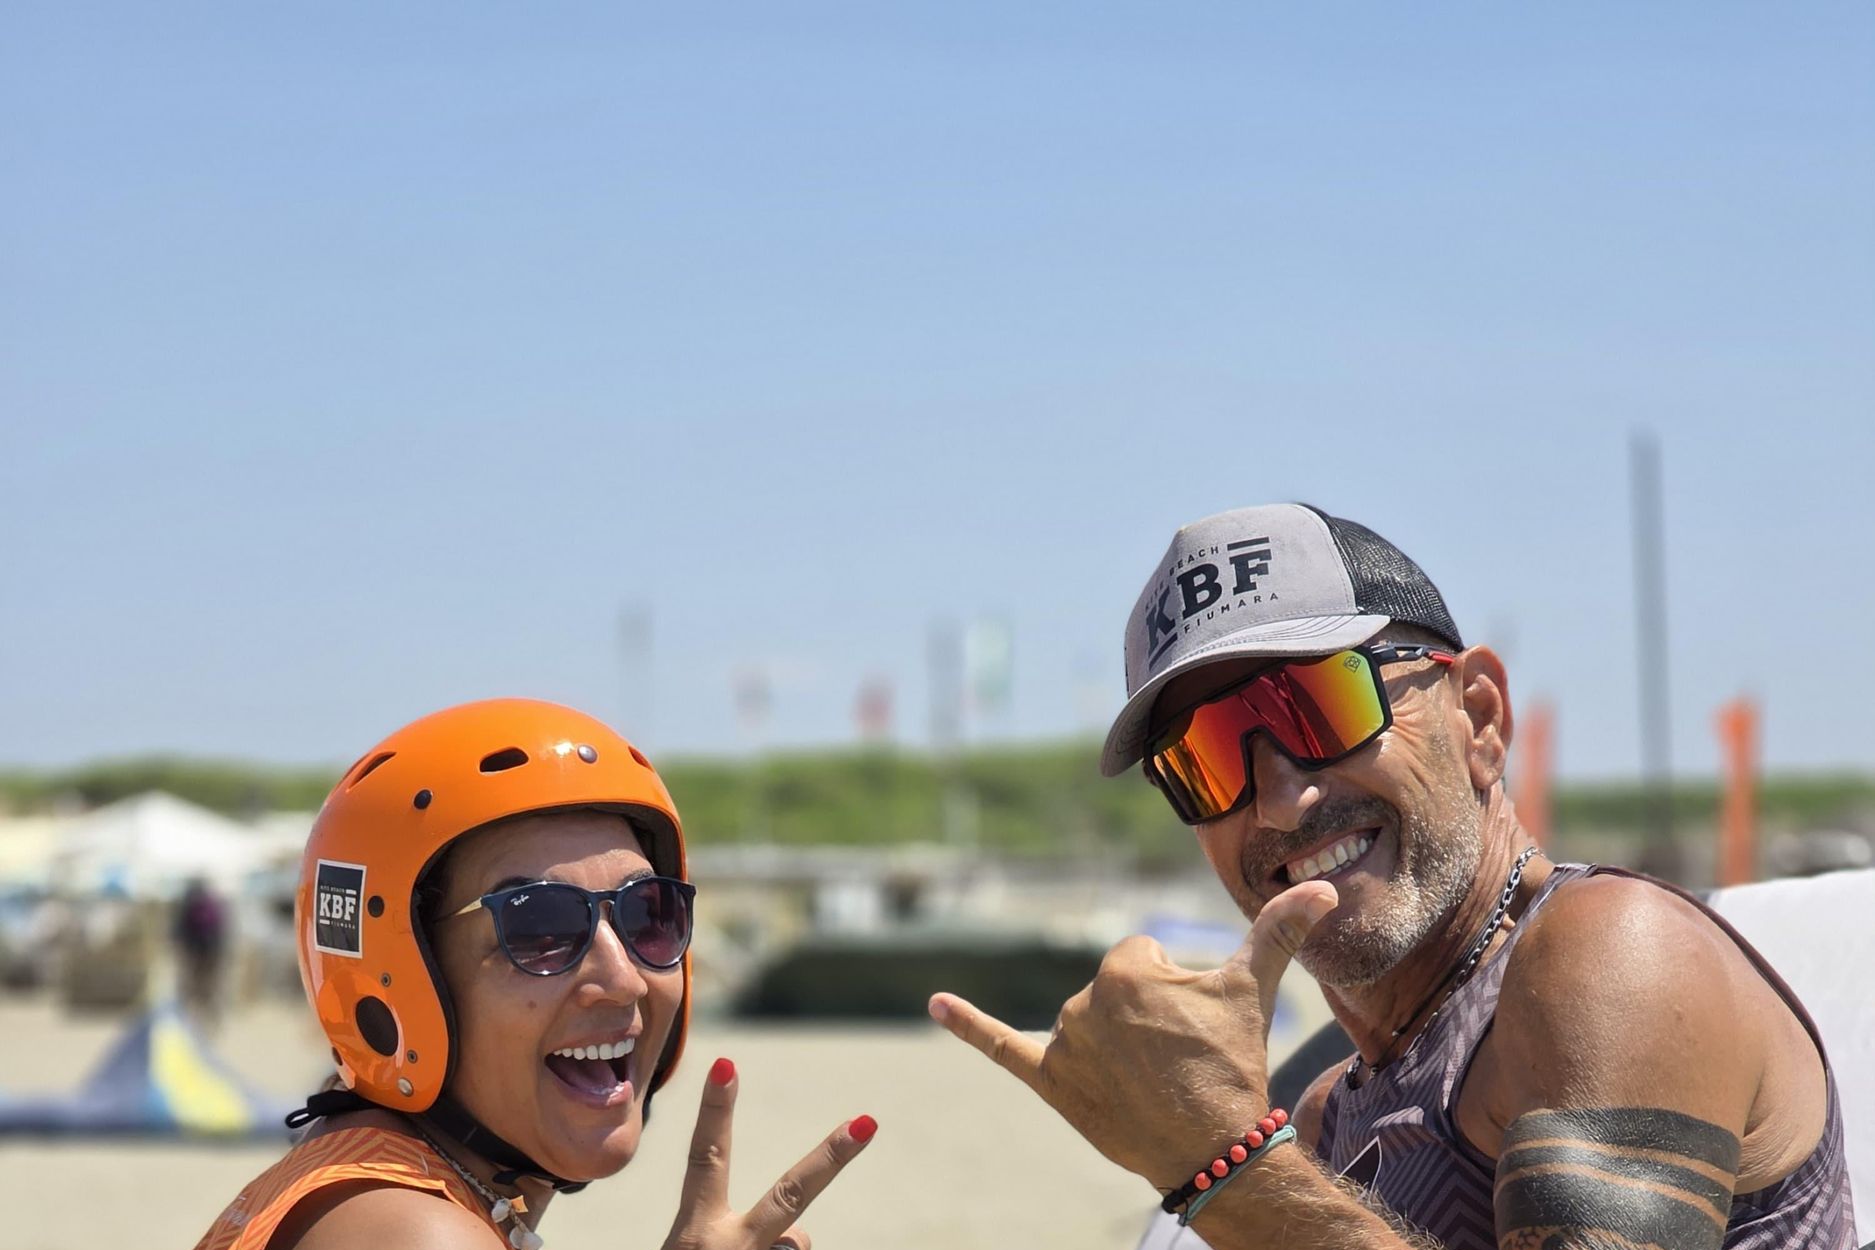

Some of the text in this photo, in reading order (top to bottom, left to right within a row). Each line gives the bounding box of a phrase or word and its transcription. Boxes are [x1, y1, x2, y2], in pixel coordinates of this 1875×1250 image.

[1146, 549, 1272, 658] KBF
[1184, 592, 1279, 634] FIUMARA
[319, 892, 357, 921] KBF
